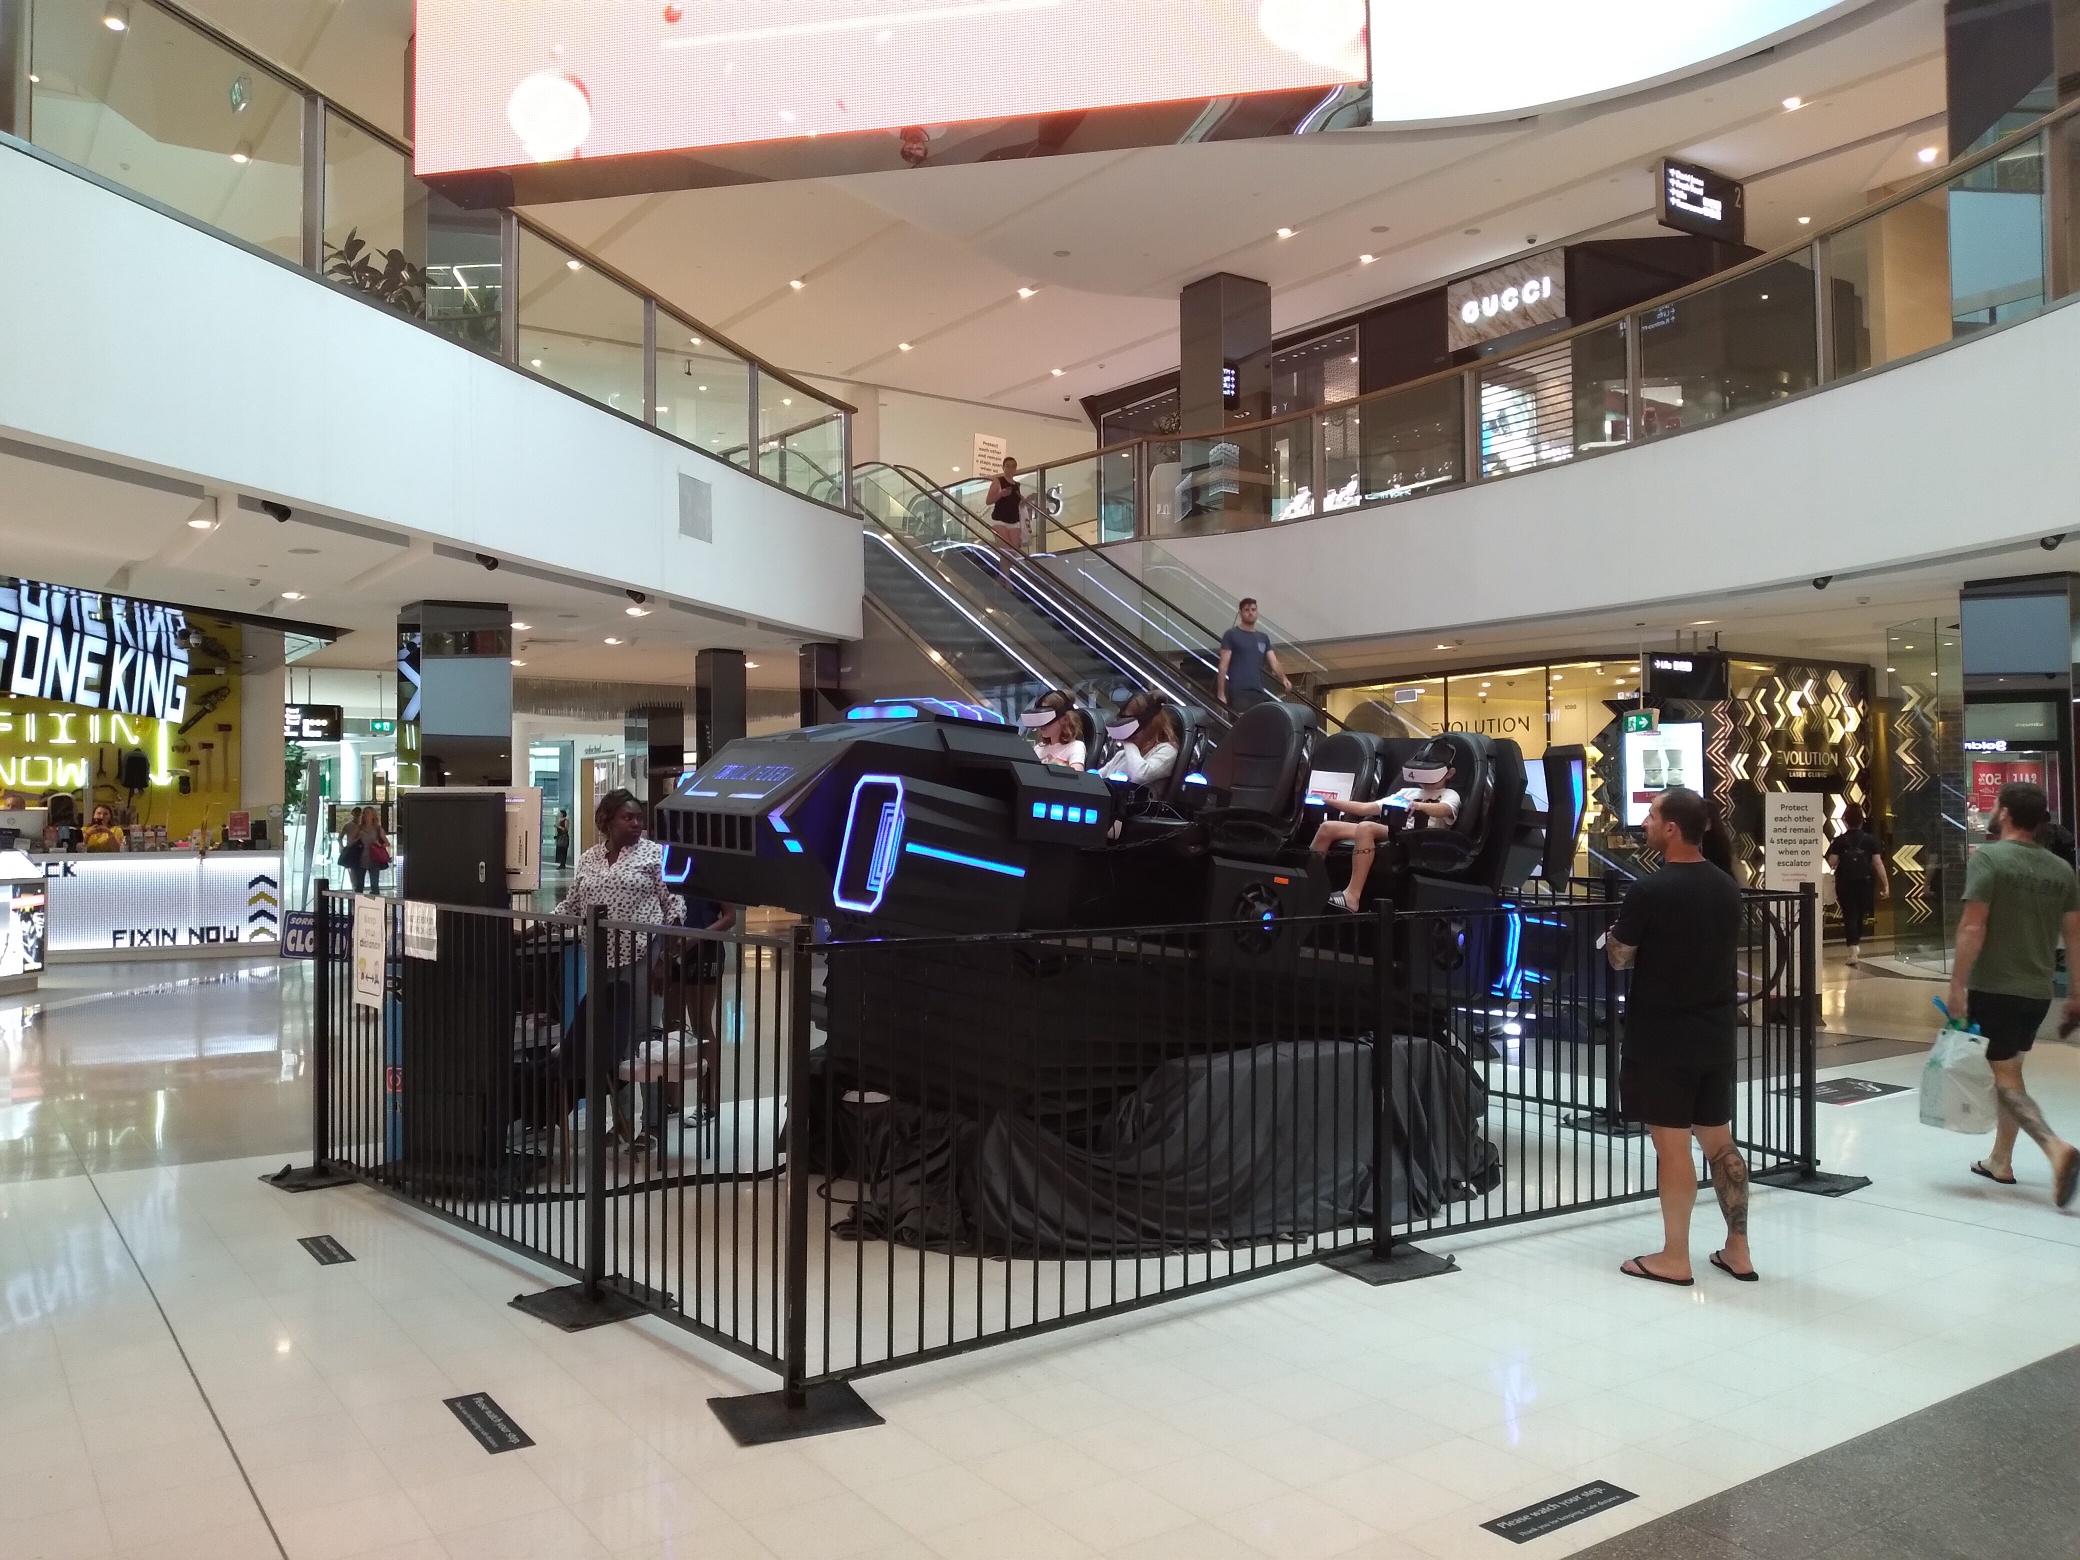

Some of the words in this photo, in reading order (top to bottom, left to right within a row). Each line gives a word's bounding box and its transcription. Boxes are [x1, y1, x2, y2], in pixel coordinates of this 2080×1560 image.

[1734, 186, 1742, 209] 2
[1462, 276, 1551, 324] GUCCI
[108, 643, 189, 724] KING
[1777, 750, 1839, 767] EVOLUTION
[0, 756, 88, 786] NOW
[1408, 771, 1415, 780] 4
[1780, 804, 1809, 812] Protect
[1774, 815, 1792, 823] each
[1794, 815, 1815, 823] other
[1773, 826, 1788, 834] and
[1789, 826, 1816, 834] remain
[1776, 838, 1797, 846] steps
[1798, 838, 1819, 846] apart
[1778, 848, 1799, 856] when
[37, 861, 77, 878] CK
[1777, 859, 1812, 867] escalator
[289, 916, 314, 926] SORR
[112, 928, 177, 948] FIXIN
[188, 925, 240, 945] NOW
[1496, 1514, 1533, 1529] Please
[1530, 1502, 1561, 1517] watch
[1558, 1494, 1584, 1508] your
[1580, 1486, 1606, 1498] step.
